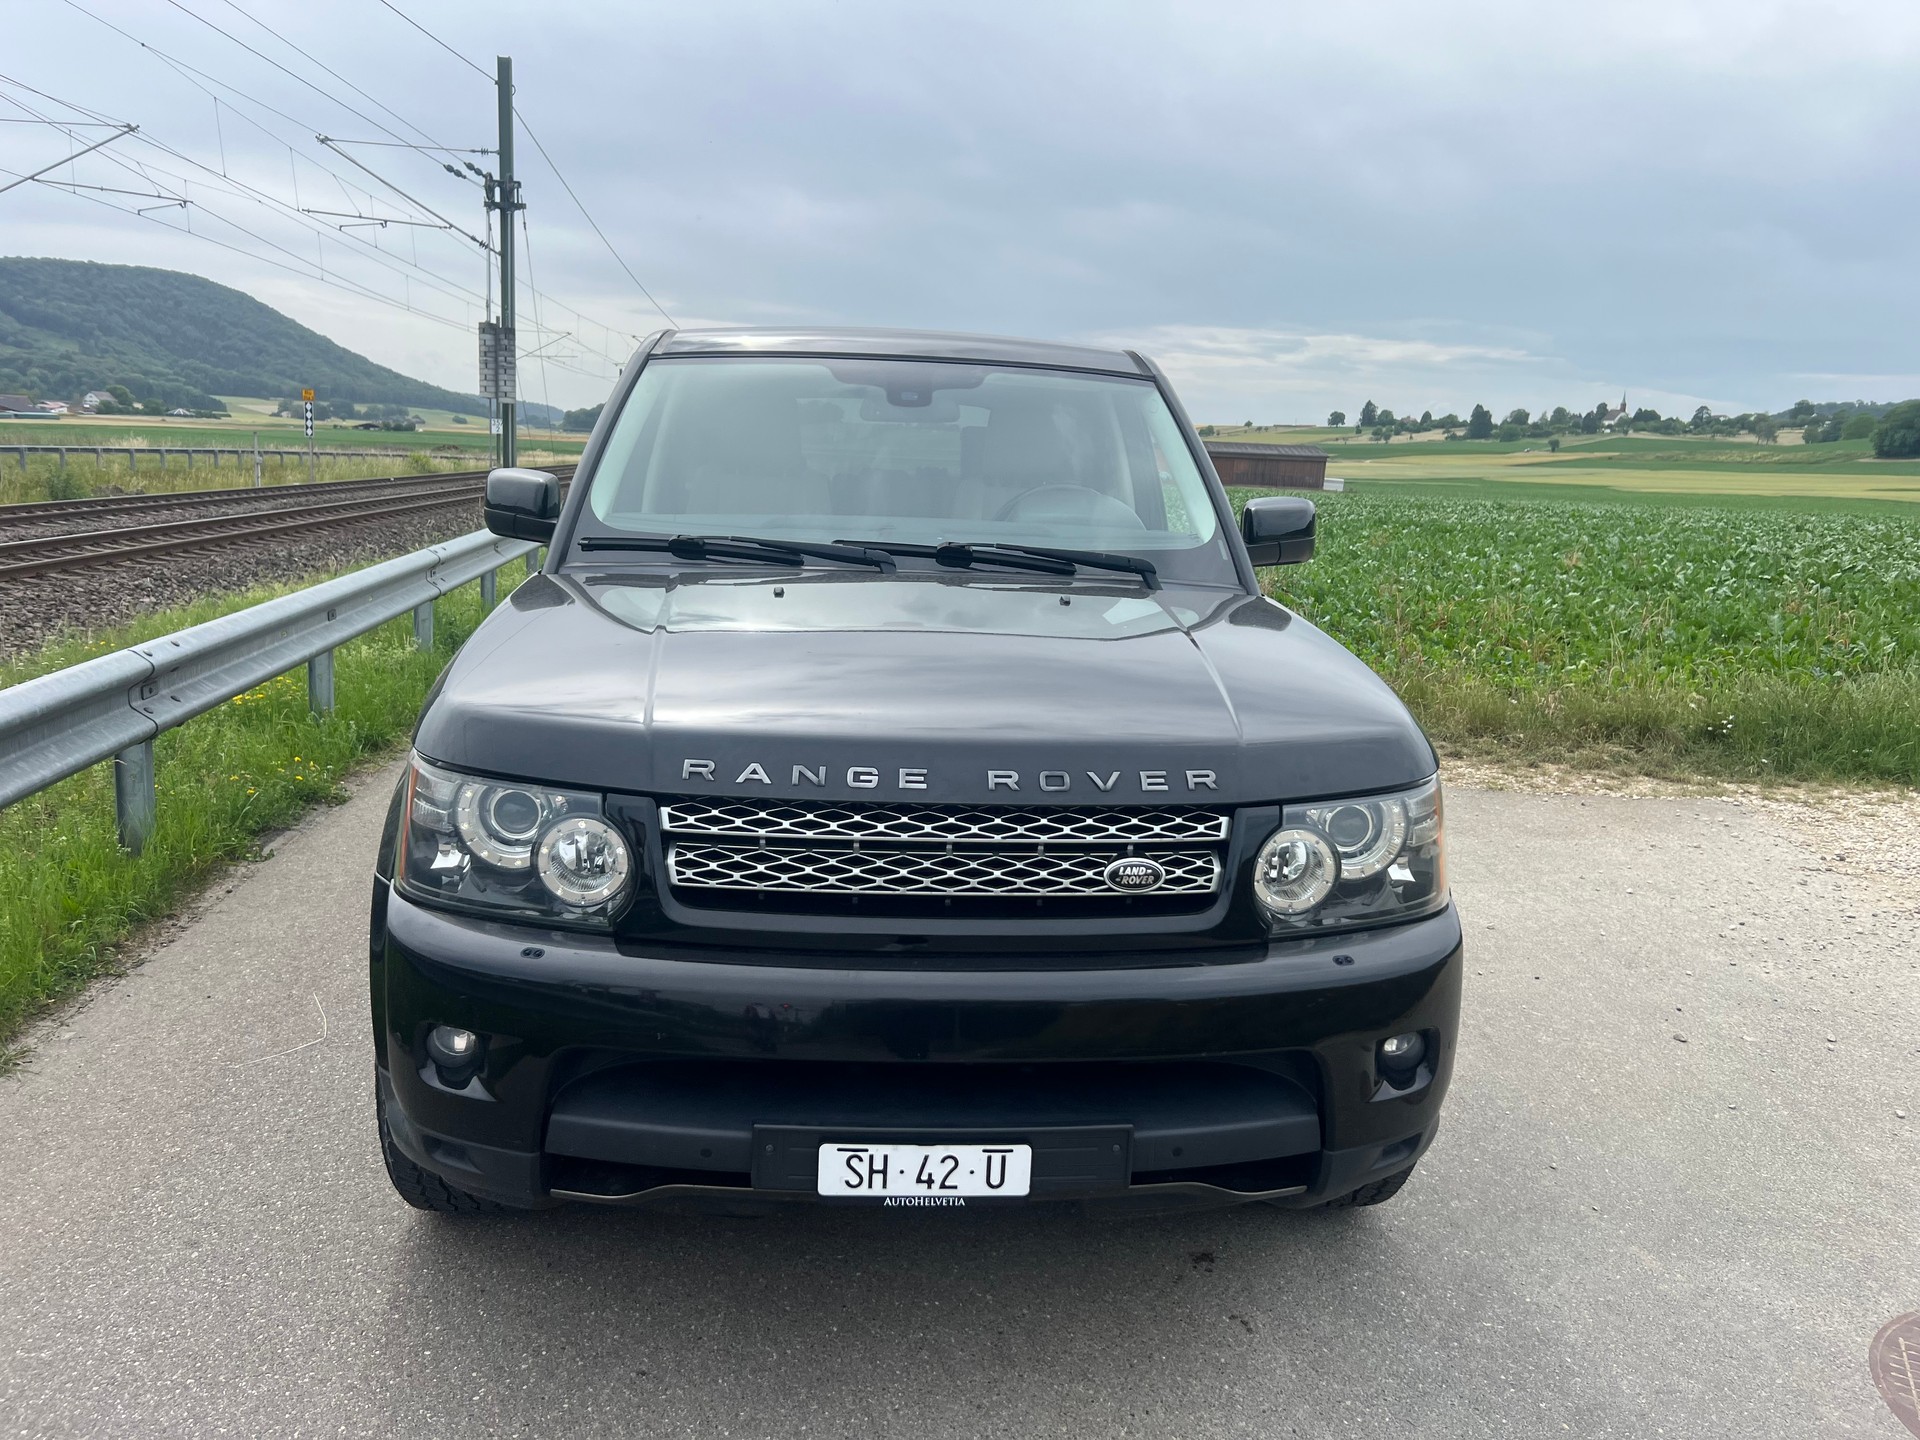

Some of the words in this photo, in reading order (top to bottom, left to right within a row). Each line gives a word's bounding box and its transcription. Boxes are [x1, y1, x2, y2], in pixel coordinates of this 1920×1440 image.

[681, 759, 929, 790] RANGE
[987, 769, 1220, 792] ROVER
[1118, 866, 1147, 876] LAND
[1120, 875, 1155, 885] ROVER
